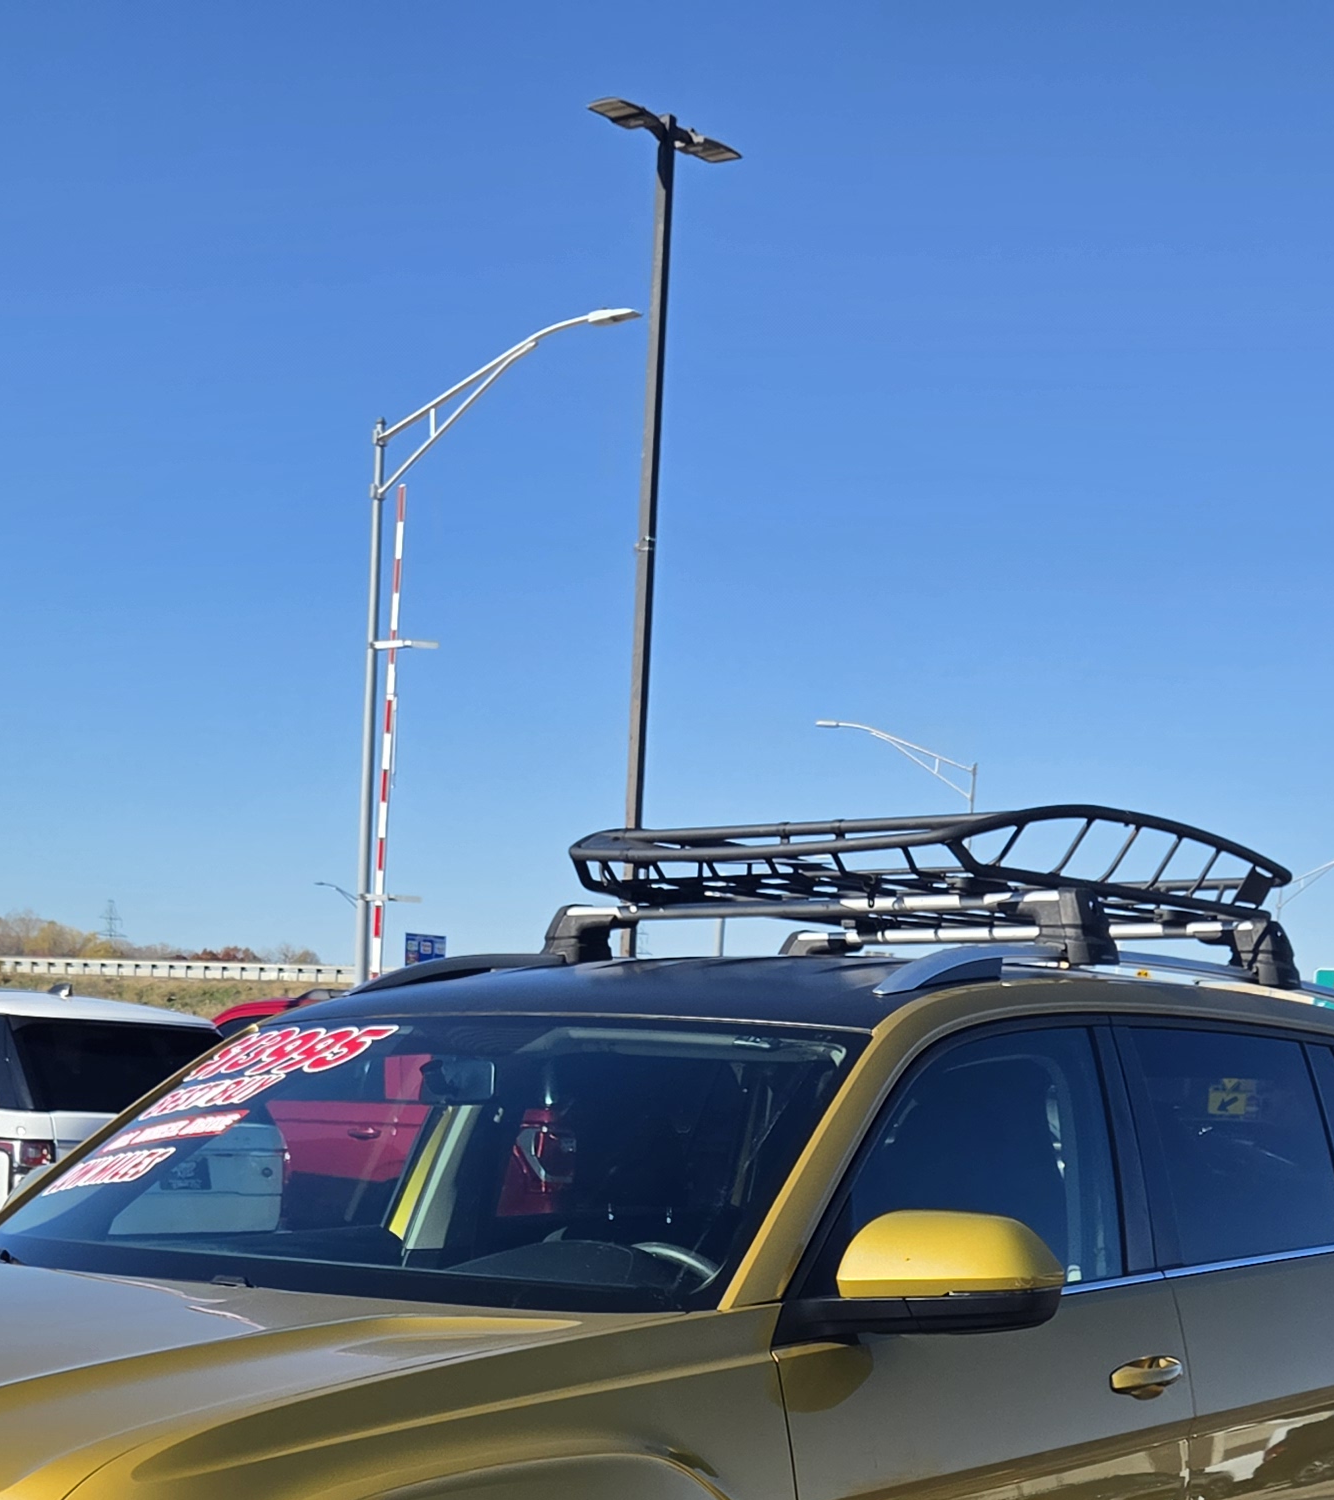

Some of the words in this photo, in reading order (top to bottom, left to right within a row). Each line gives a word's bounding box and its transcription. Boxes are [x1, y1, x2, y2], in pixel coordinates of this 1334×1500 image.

[183, 1025, 399, 1082] $13995
[138, 1080, 223, 1121] BEST
[204, 1073, 286, 1106] BUY
[78, 1146, 177, 1187] MILES
